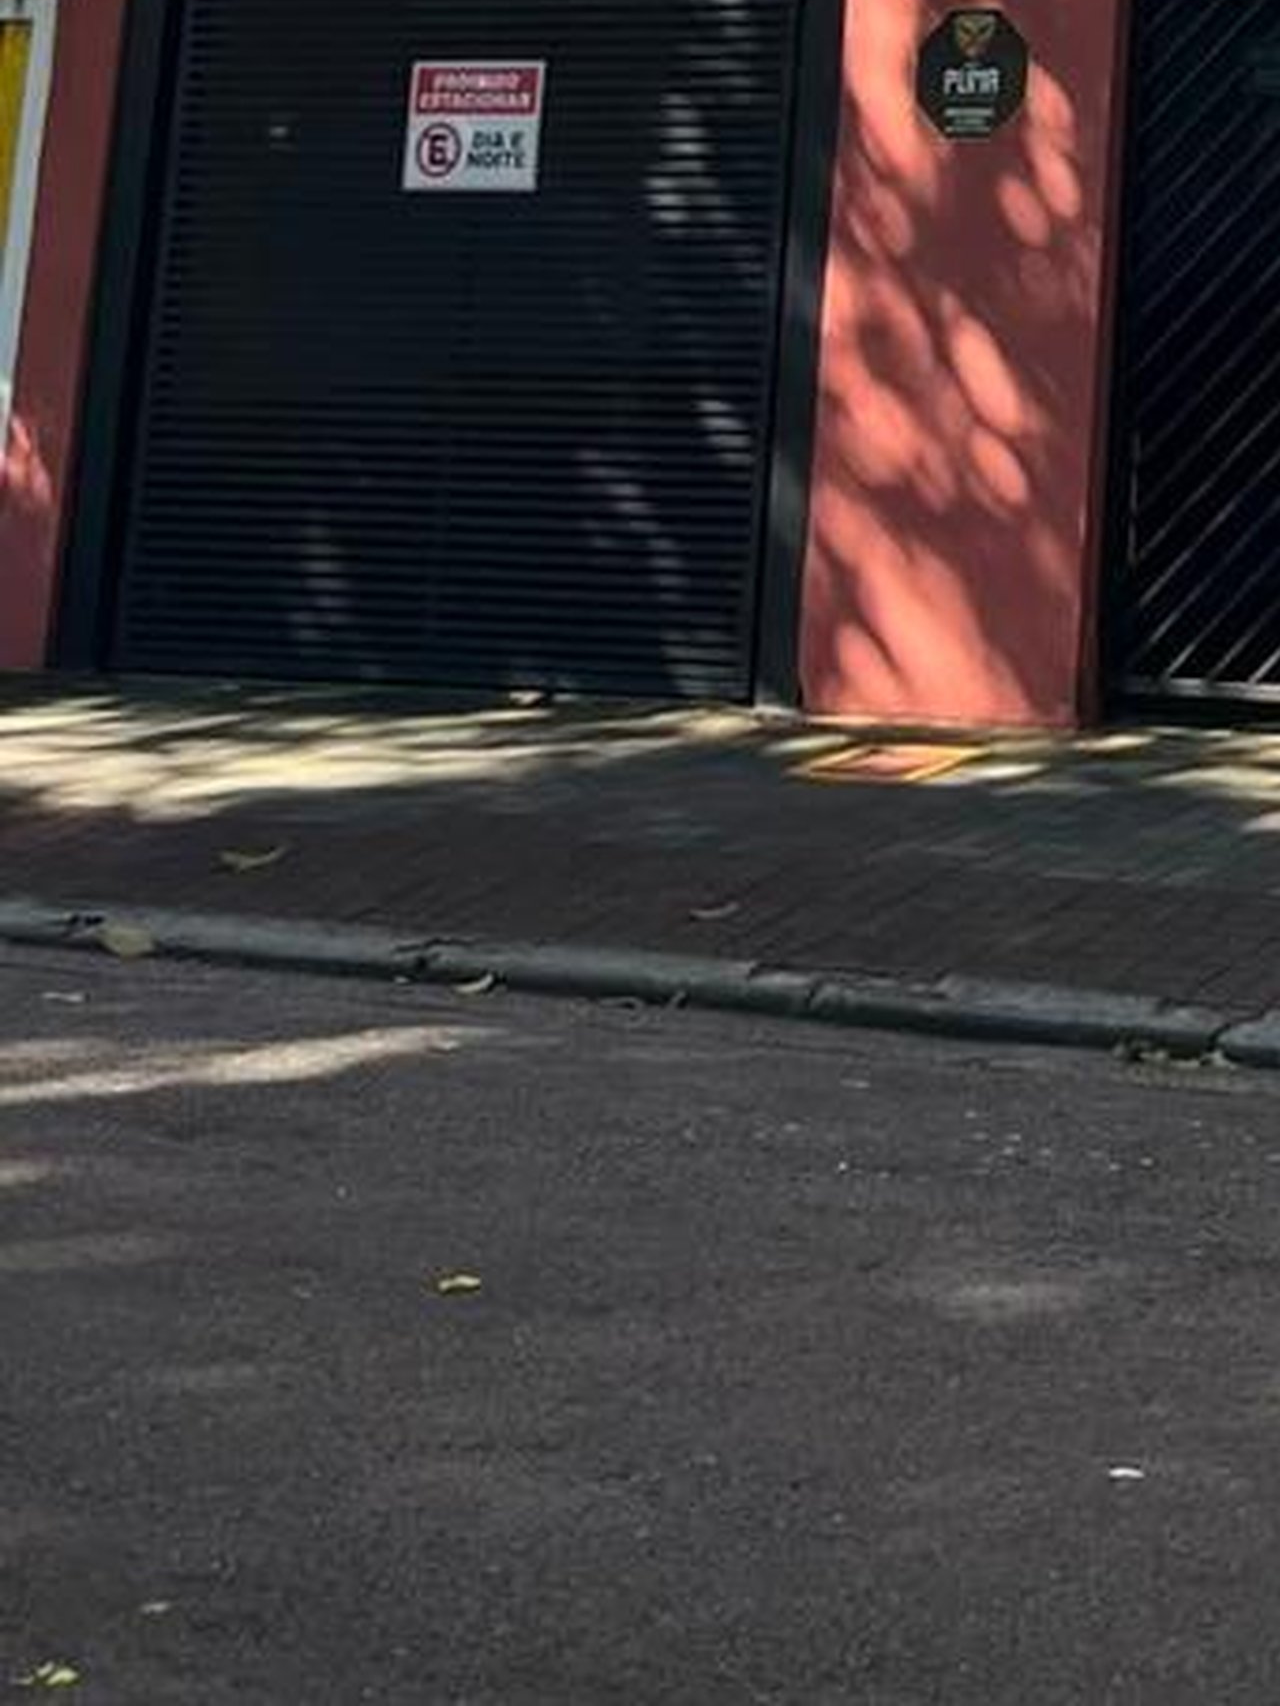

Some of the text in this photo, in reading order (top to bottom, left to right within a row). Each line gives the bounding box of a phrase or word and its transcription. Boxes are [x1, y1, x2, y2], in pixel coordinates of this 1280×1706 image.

[432, 72, 520, 89] PROIBIDO
[418, 92, 531, 109] ESTACIONAR
[472, 131, 506, 148] DIA
[466, 151, 525, 169] NOITE
